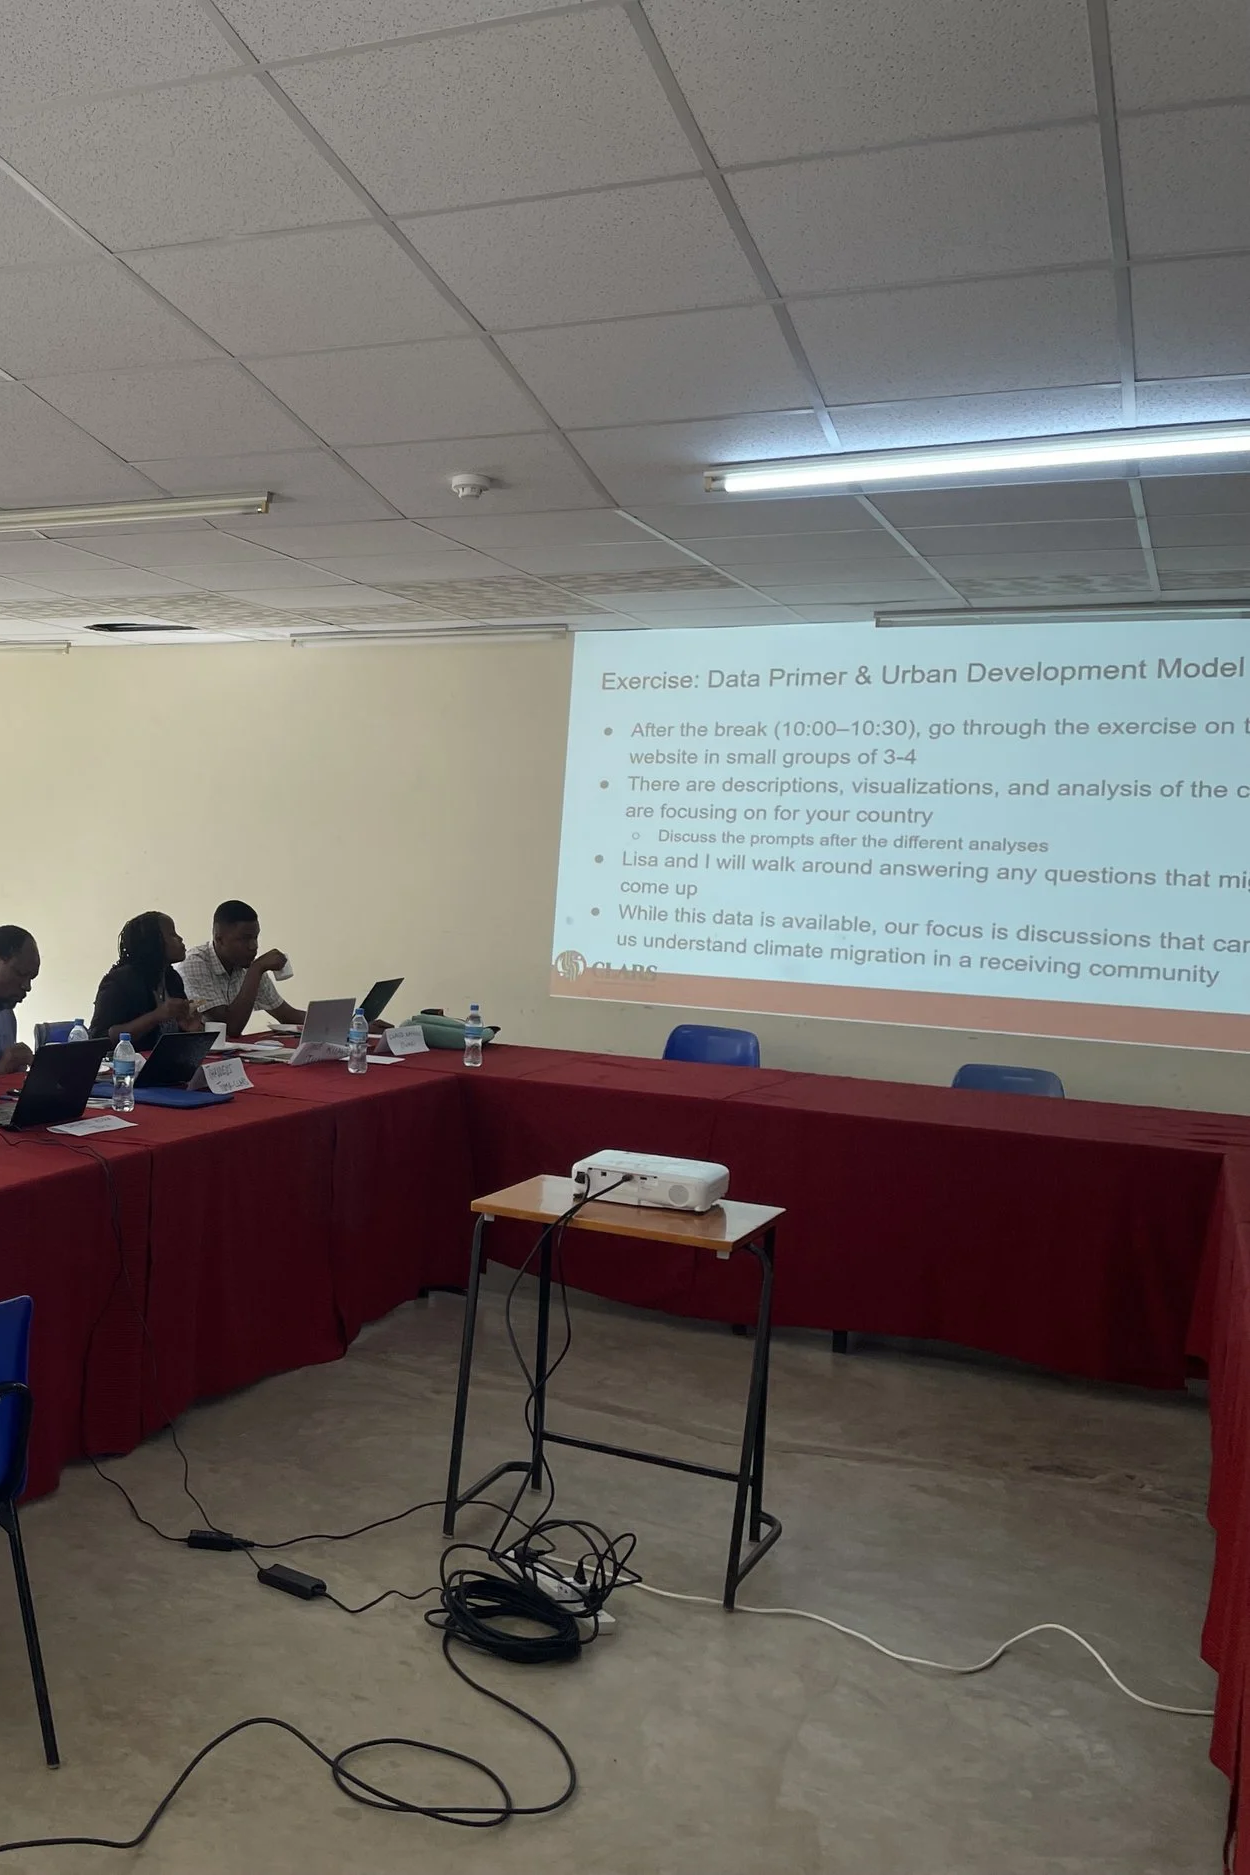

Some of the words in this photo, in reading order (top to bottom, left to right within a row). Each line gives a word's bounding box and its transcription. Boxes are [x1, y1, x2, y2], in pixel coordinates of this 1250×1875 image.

[601, 670, 699, 690] Exercise:
[707, 669, 760, 688] Data
[768, 667, 848, 687] Primer
[854, 665, 872, 685] &
[881, 664, 957, 684] Urban
[967, 659, 1147, 686] Development
[1156, 655, 1244, 679] Model
[629, 721, 675, 738] After
[679, 721, 708, 737] the
[713, 720, 767, 737] break
[928, 722, 955, 739] go
[962, 718, 1046, 739] through
[1053, 717, 1090, 735] the
[1096, 716, 1196, 735] exercise
[1204, 719, 1234, 734] on
[629, 748, 698, 764] website
[704, 748, 719, 764] in
[725, 748, 776, 764] small
[782, 751, 851, 768] groups
[857, 748, 878, 765] of
[882, 748, 917, 764] 3-4
[627, 775, 680, 792] There
[685, 778, 715, 792] are
[721, 776, 843, 796] descriptions,
[851, 777, 998, 798] visualizations,
[1007, 778, 1049, 796] and
[1056, 779, 1151, 800] analysis
[1159, 779, 1184, 797] of
[1189, 779, 1228, 798] the
[1236, 784, 1250, 798] c
[624, 804, 654, 818] are
[659, 802, 737, 824] focusing
[743, 807, 766, 820] on
[773, 804, 800, 821] for
[805, 808, 850, 825] your
[855, 807, 933, 827] country
[658, 828, 717, 843] Discuss
[721, 830, 745, 844] the
[749, 832, 814, 849] prompts
[819, 832, 858, 847] after
[861, 833, 888, 848] the
[892, 833, 963, 850] different
[967, 836, 1048, 855] analyses
[622, 850, 658, 867] Lisa
[663, 852, 698, 868] and
[705, 852, 710, 869] I
[715, 853, 746, 870] will
[751, 855, 796, 872] walk
[801, 858, 872, 875] around
[878, 860, 989, 883] answering
[995, 866, 1037, 885] any
[1044, 866, 1156, 886] questions
[1165, 868, 1211, 887] that
[1218, 870, 1250, 892] mi
[620, 880, 669, 894] come
[675, 882, 698, 900] up
[618, 903, 668, 922] While
[674, 906, 706, 924] this
[711, 908, 753, 926] data
[759, 910, 775, 927] is
[781, 913, 876, 936] available,
[884, 920, 920, 935] our
[925, 919, 983, 939] focus
[991, 922, 1008, 940] is
[1015, 923, 1151, 948] discussions
[1159, 931, 1205, 951] that
[616, 933, 637, 946] us
[643, 933, 747, 953] understand
[753, 939, 823, 958] climate
[829, 944, 925, 965] migration
[933, 948, 951, 967] in
[958, 955, 971, 968] a
[979, 954, 1081, 979] receiving
[1088, 962, 1220, 988] community
